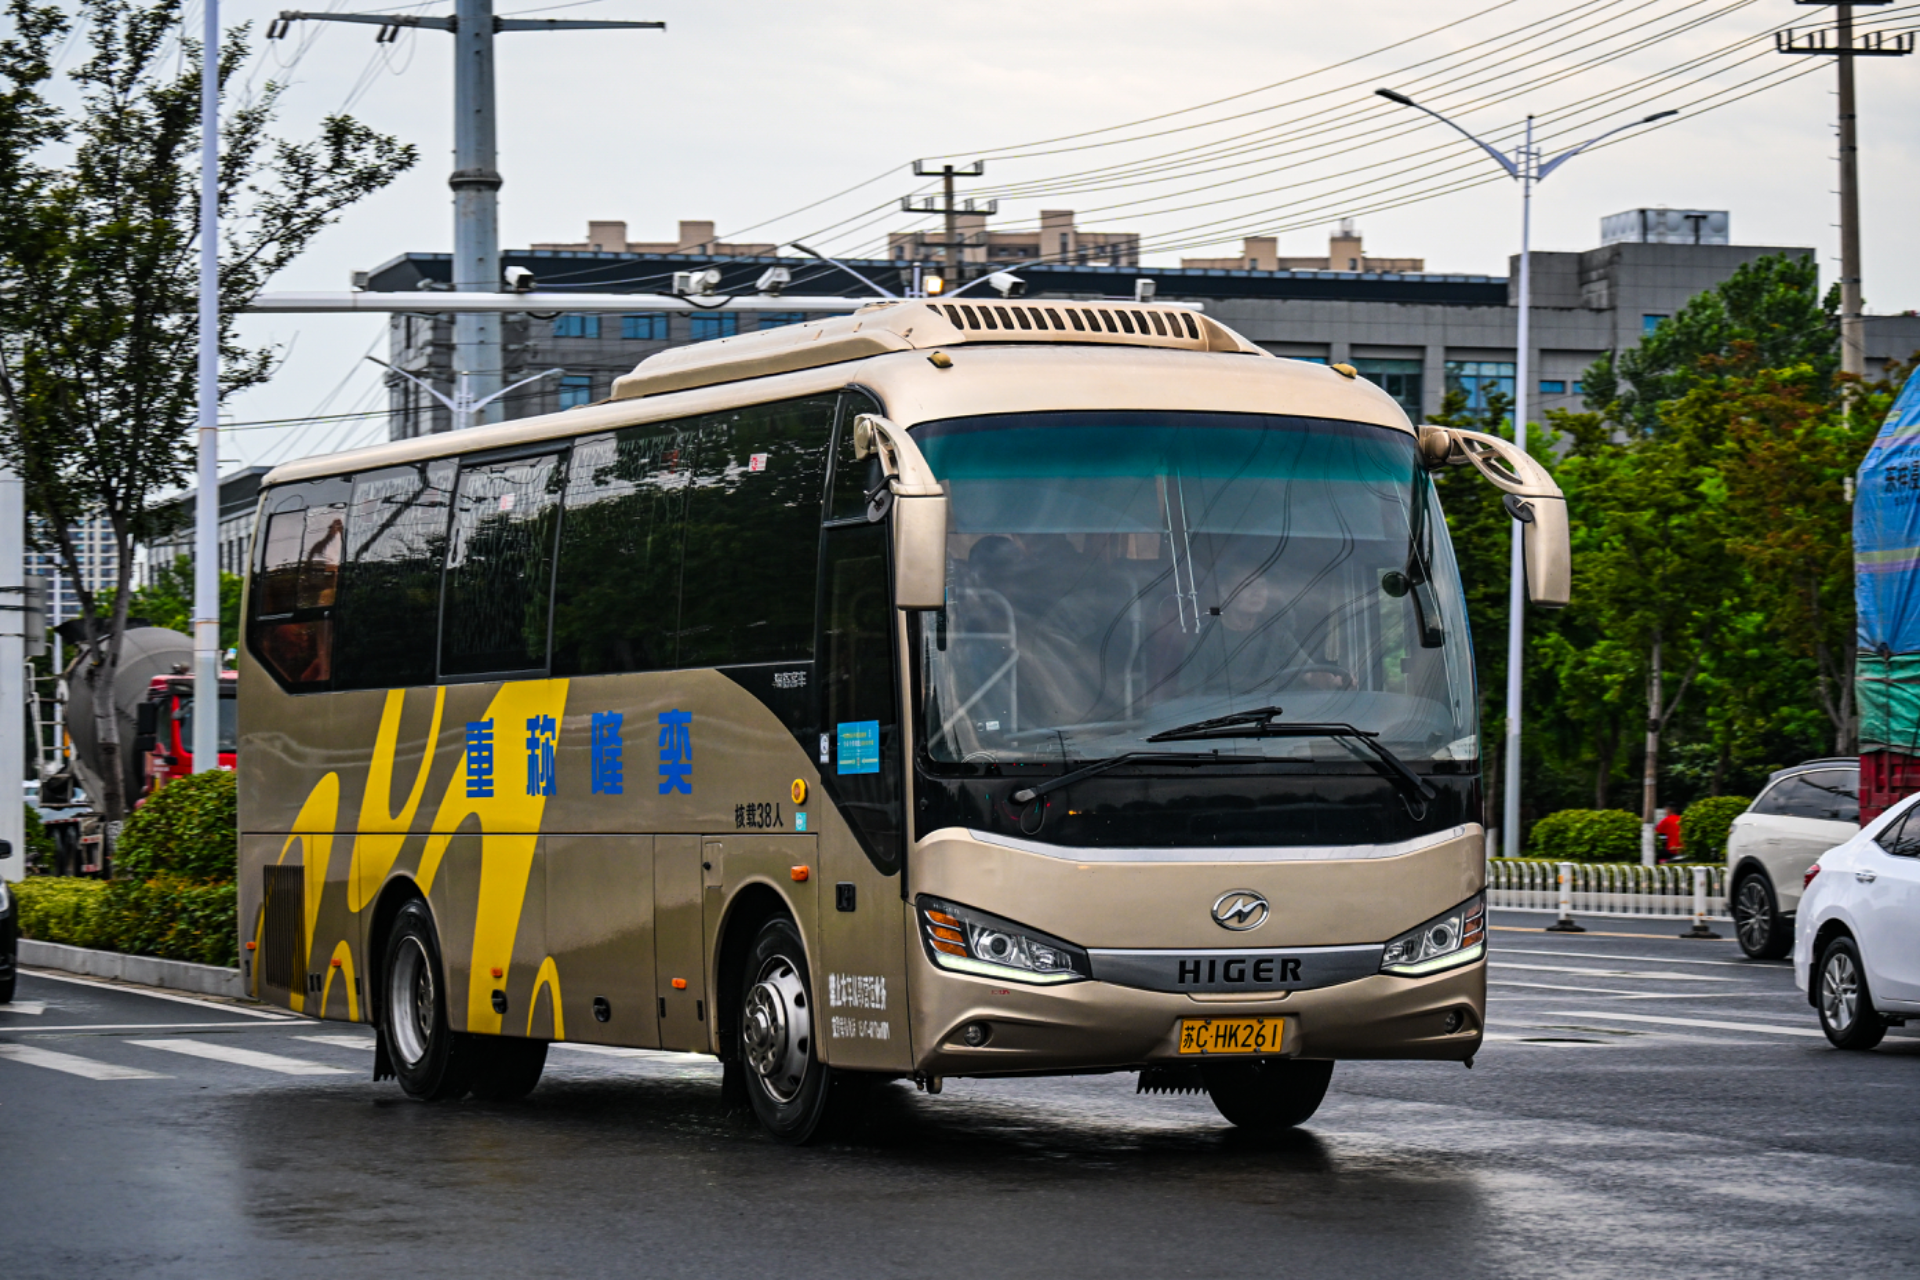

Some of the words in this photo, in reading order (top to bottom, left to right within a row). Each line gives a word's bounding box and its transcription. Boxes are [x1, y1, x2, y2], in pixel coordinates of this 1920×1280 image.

[734, 802, 784, 829] 核载38人
[1177, 958, 1302, 984] HIGER
